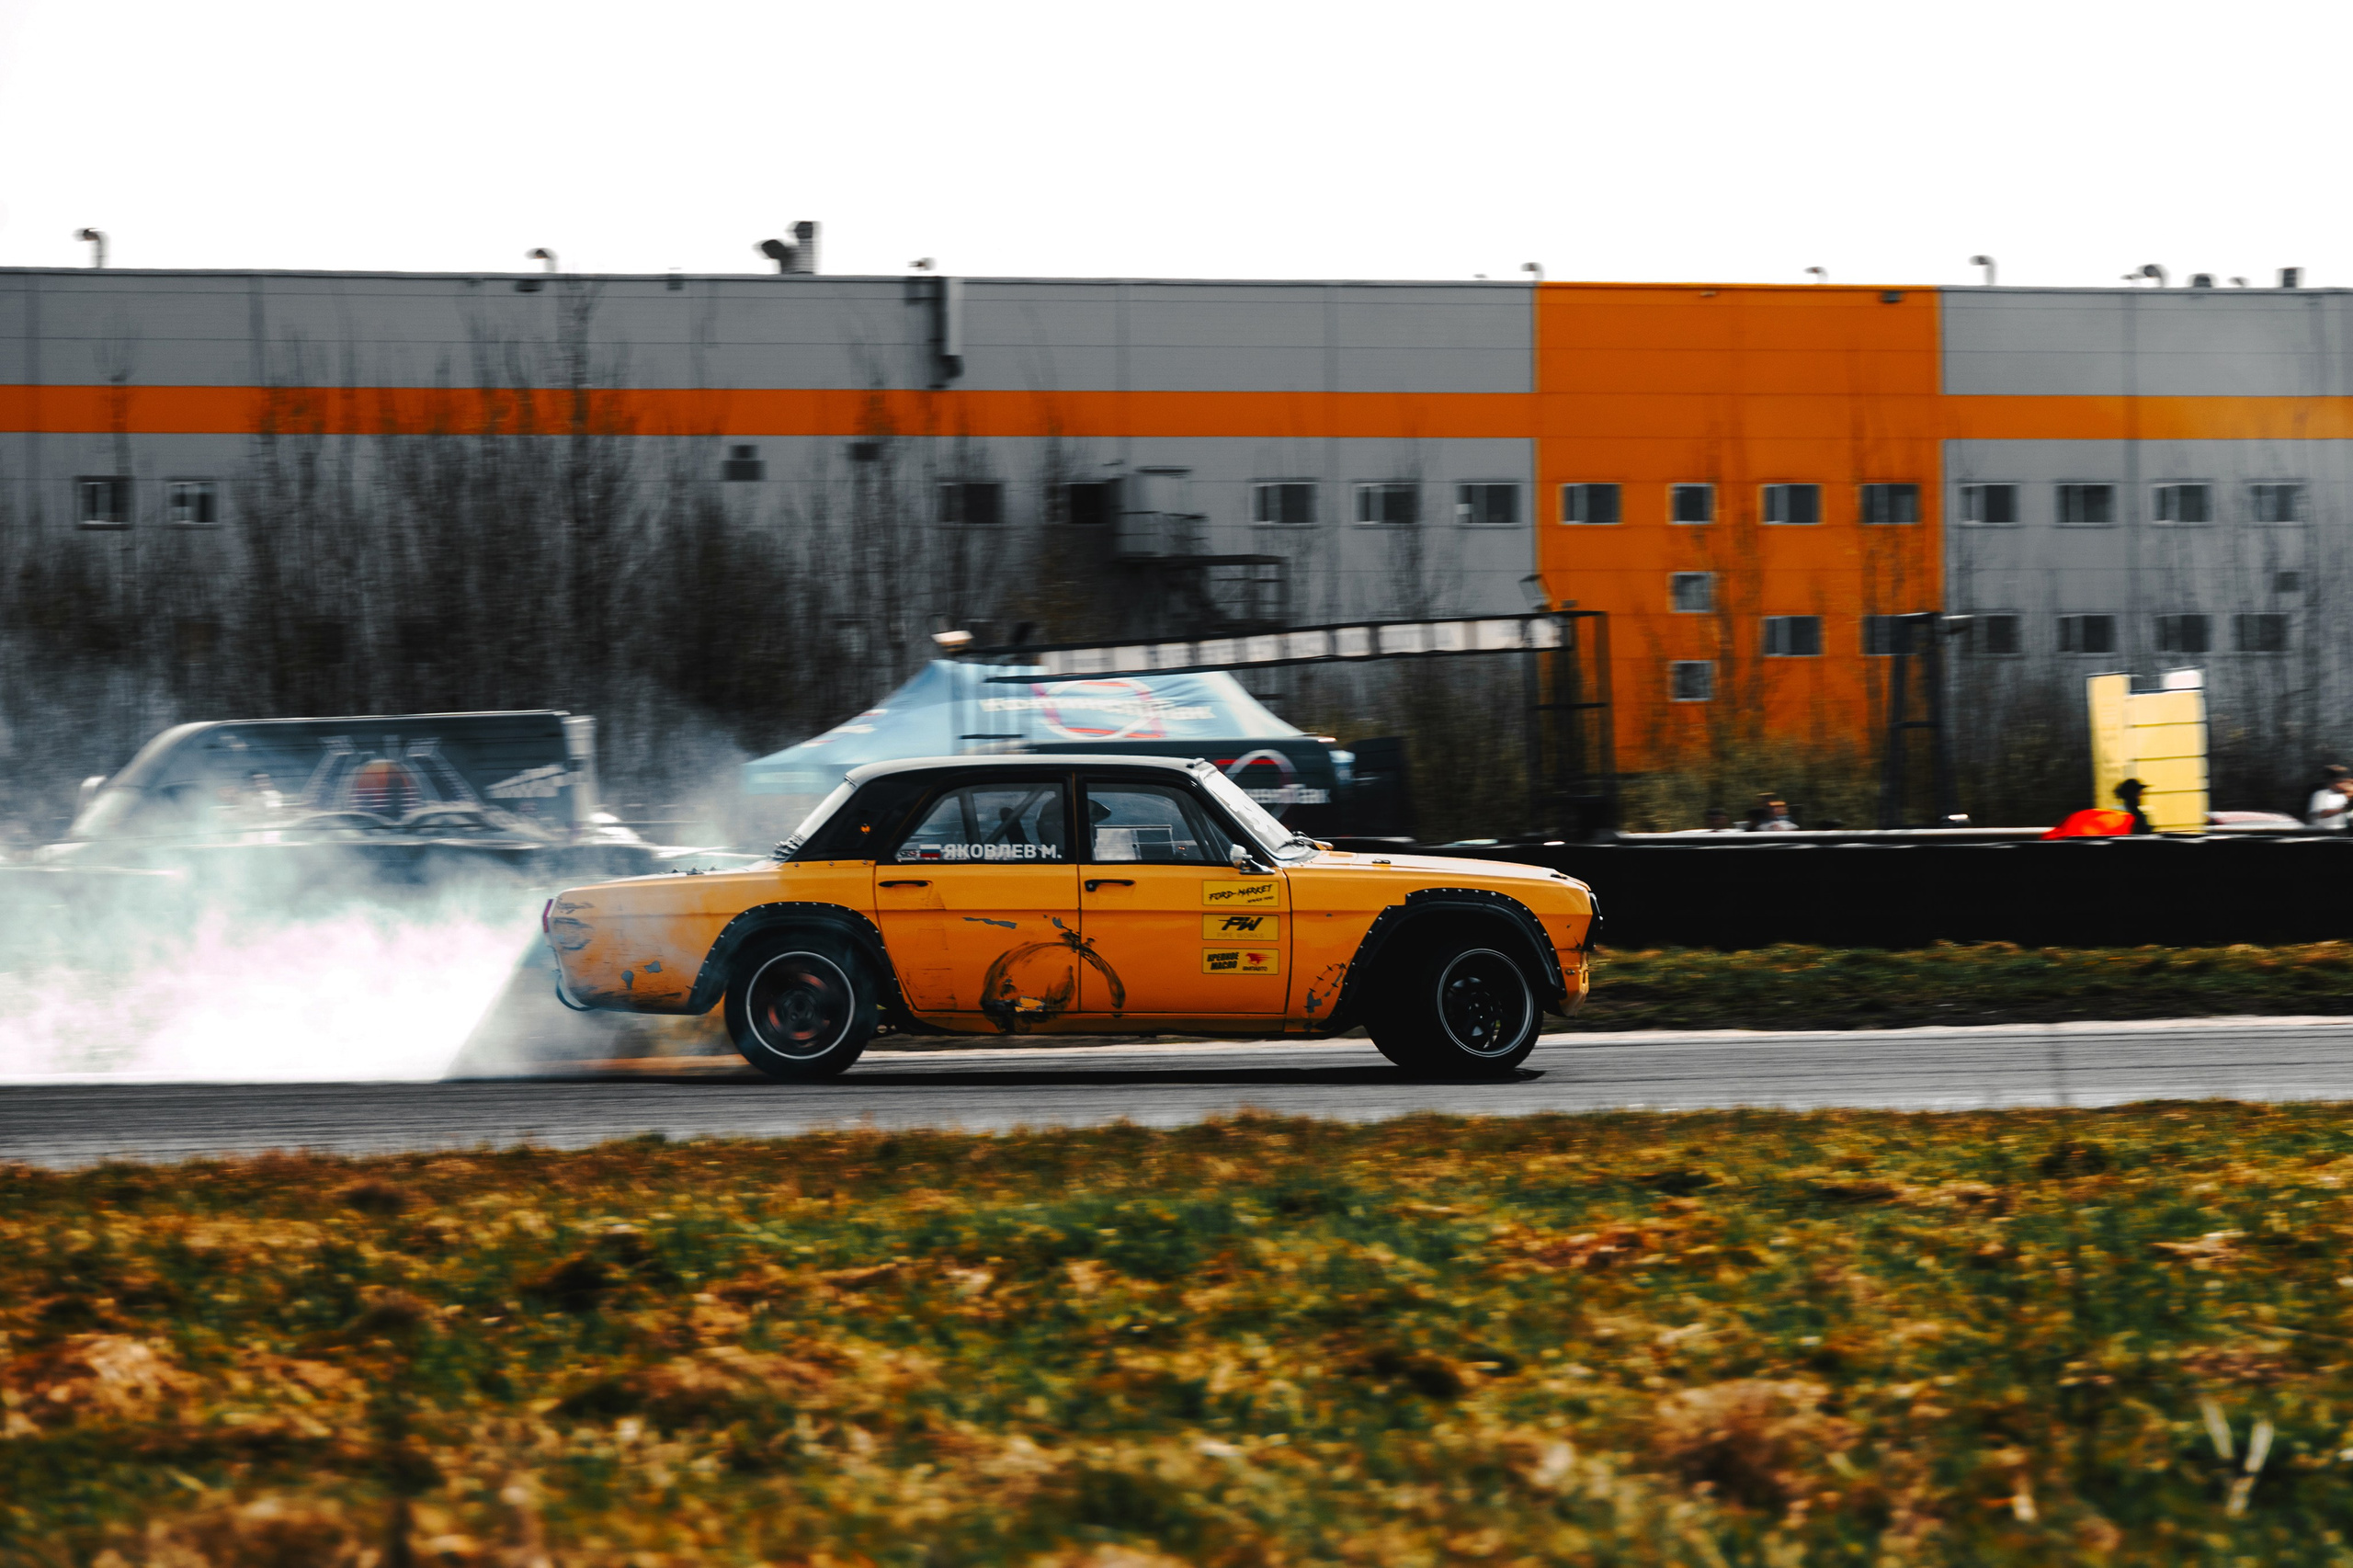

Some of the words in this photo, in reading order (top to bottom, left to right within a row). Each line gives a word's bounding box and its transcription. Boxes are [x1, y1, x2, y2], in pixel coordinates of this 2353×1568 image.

[943, 844, 1037, 859] ЯКОВЛЕВ
[1040, 844, 1063, 859] М.
[1218, 916, 1264, 930] PW
